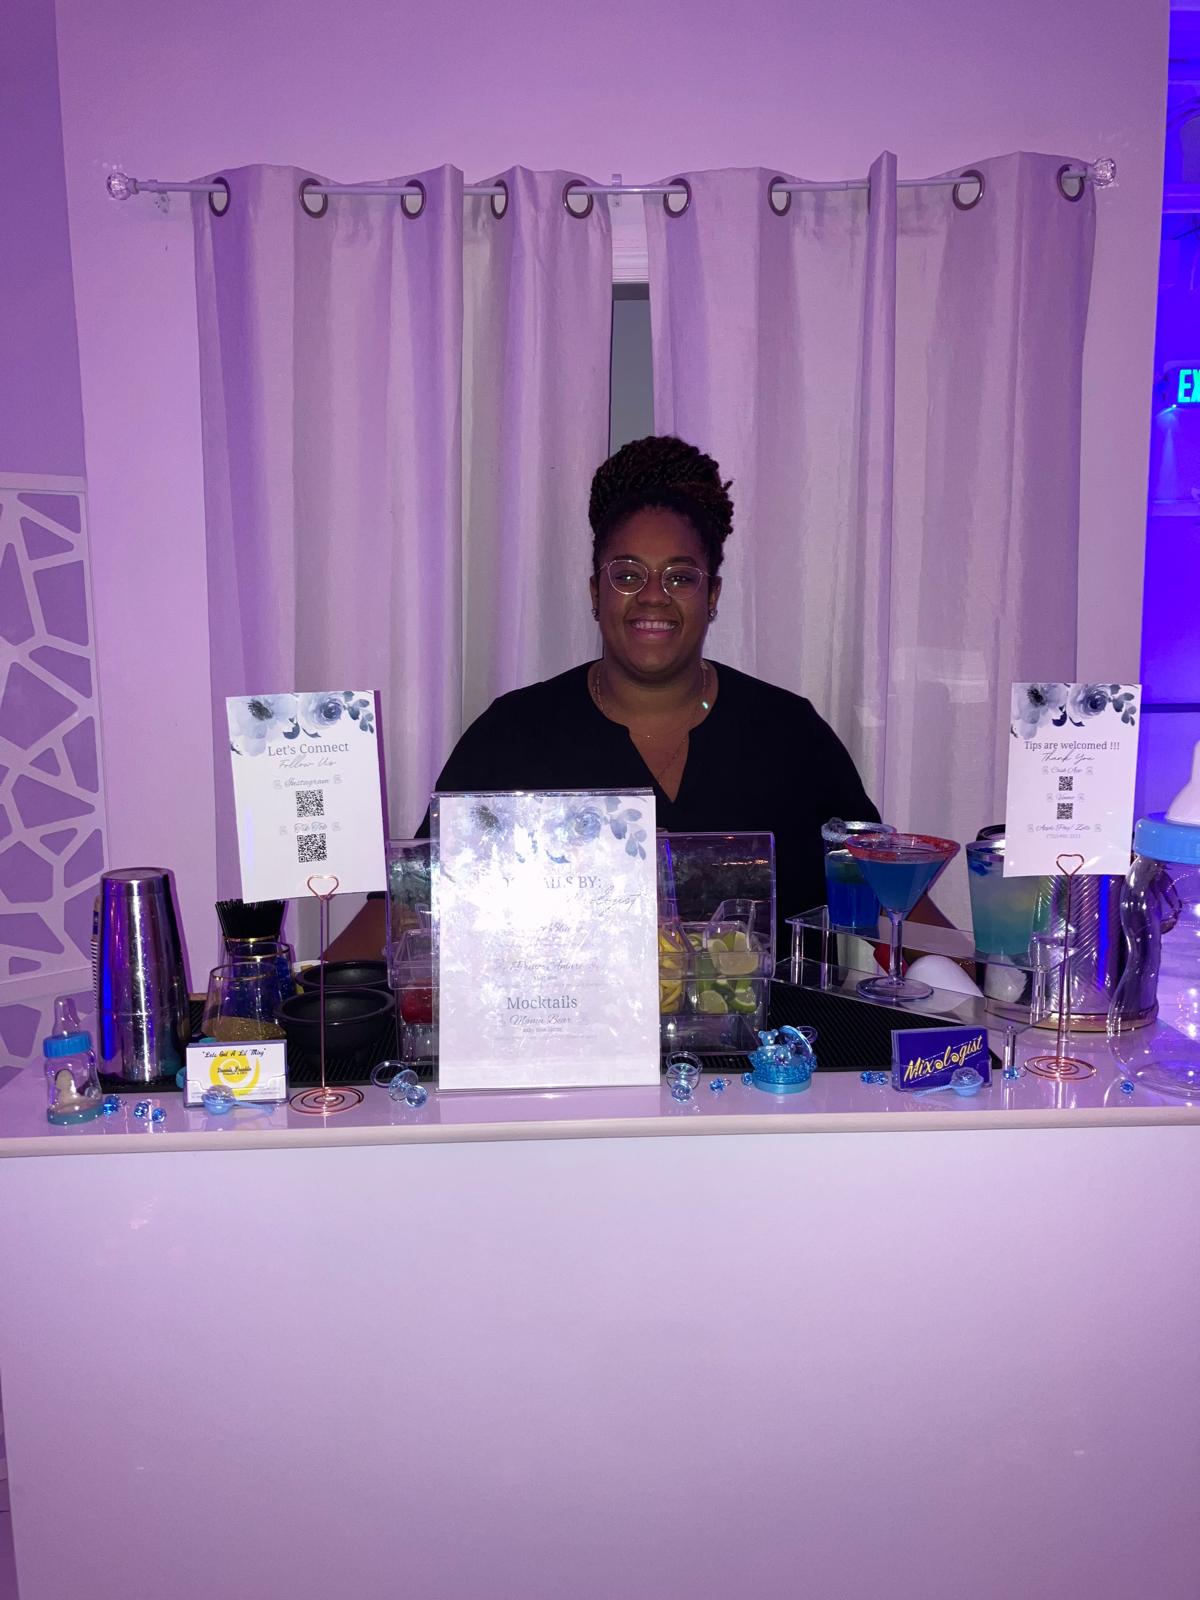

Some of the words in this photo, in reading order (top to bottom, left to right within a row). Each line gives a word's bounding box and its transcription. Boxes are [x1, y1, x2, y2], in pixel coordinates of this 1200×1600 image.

[268, 745, 297, 757] Let's
[299, 743, 350, 755] Connect
[1024, 741, 1042, 752] Tips
[1043, 742, 1059, 750] are
[1060, 741, 1108, 750] welcomed
[1109, 741, 1121, 750] !!!
[278, 754, 315, 769] Follow
[318, 757, 337, 768] Us
[1041, 749, 1073, 762] Thank
[1073, 753, 1095, 765] You
[284, 776, 330, 788] Instagram
[507, 994, 579, 1010] Mocktails
[903, 1034, 984, 1082] Mixologist
